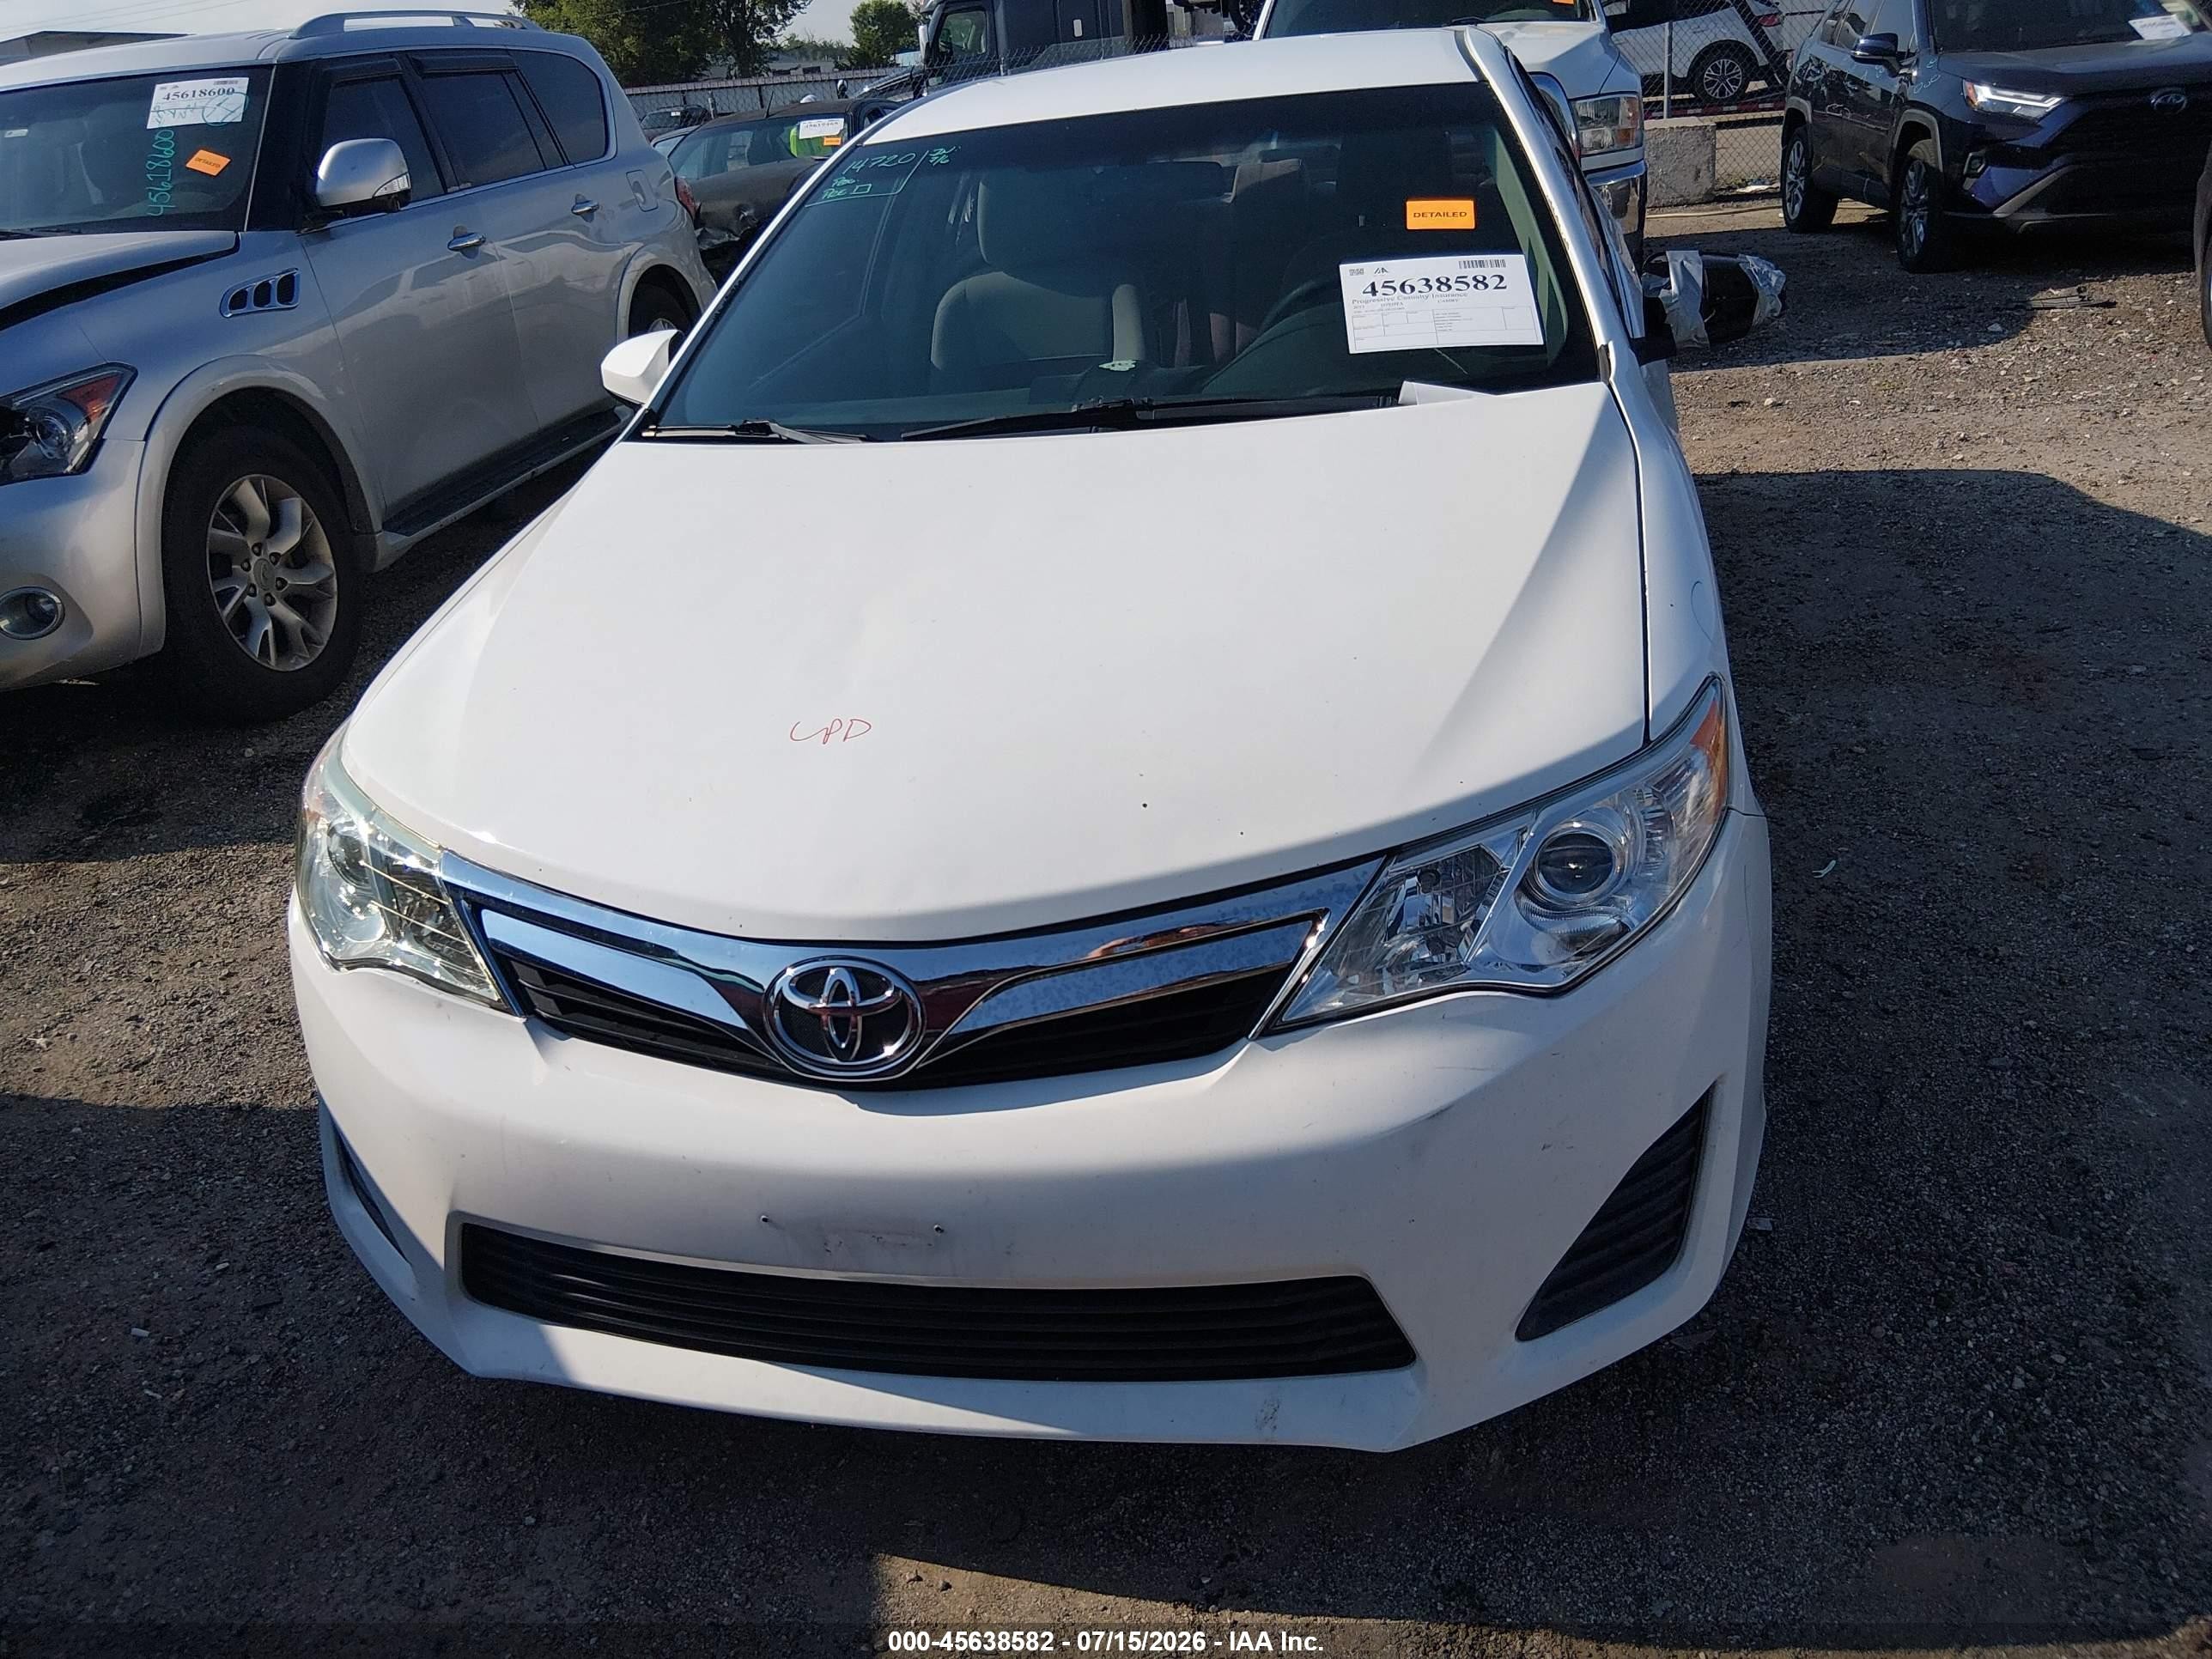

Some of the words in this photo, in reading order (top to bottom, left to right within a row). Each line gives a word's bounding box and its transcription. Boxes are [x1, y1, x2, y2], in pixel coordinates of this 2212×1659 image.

[162, 88, 235, 101] 45618600
[146, 130, 176, 216] 45618600
[842, 153, 916, 174] 14720
[1362, 274, 1508, 297] 45638582
